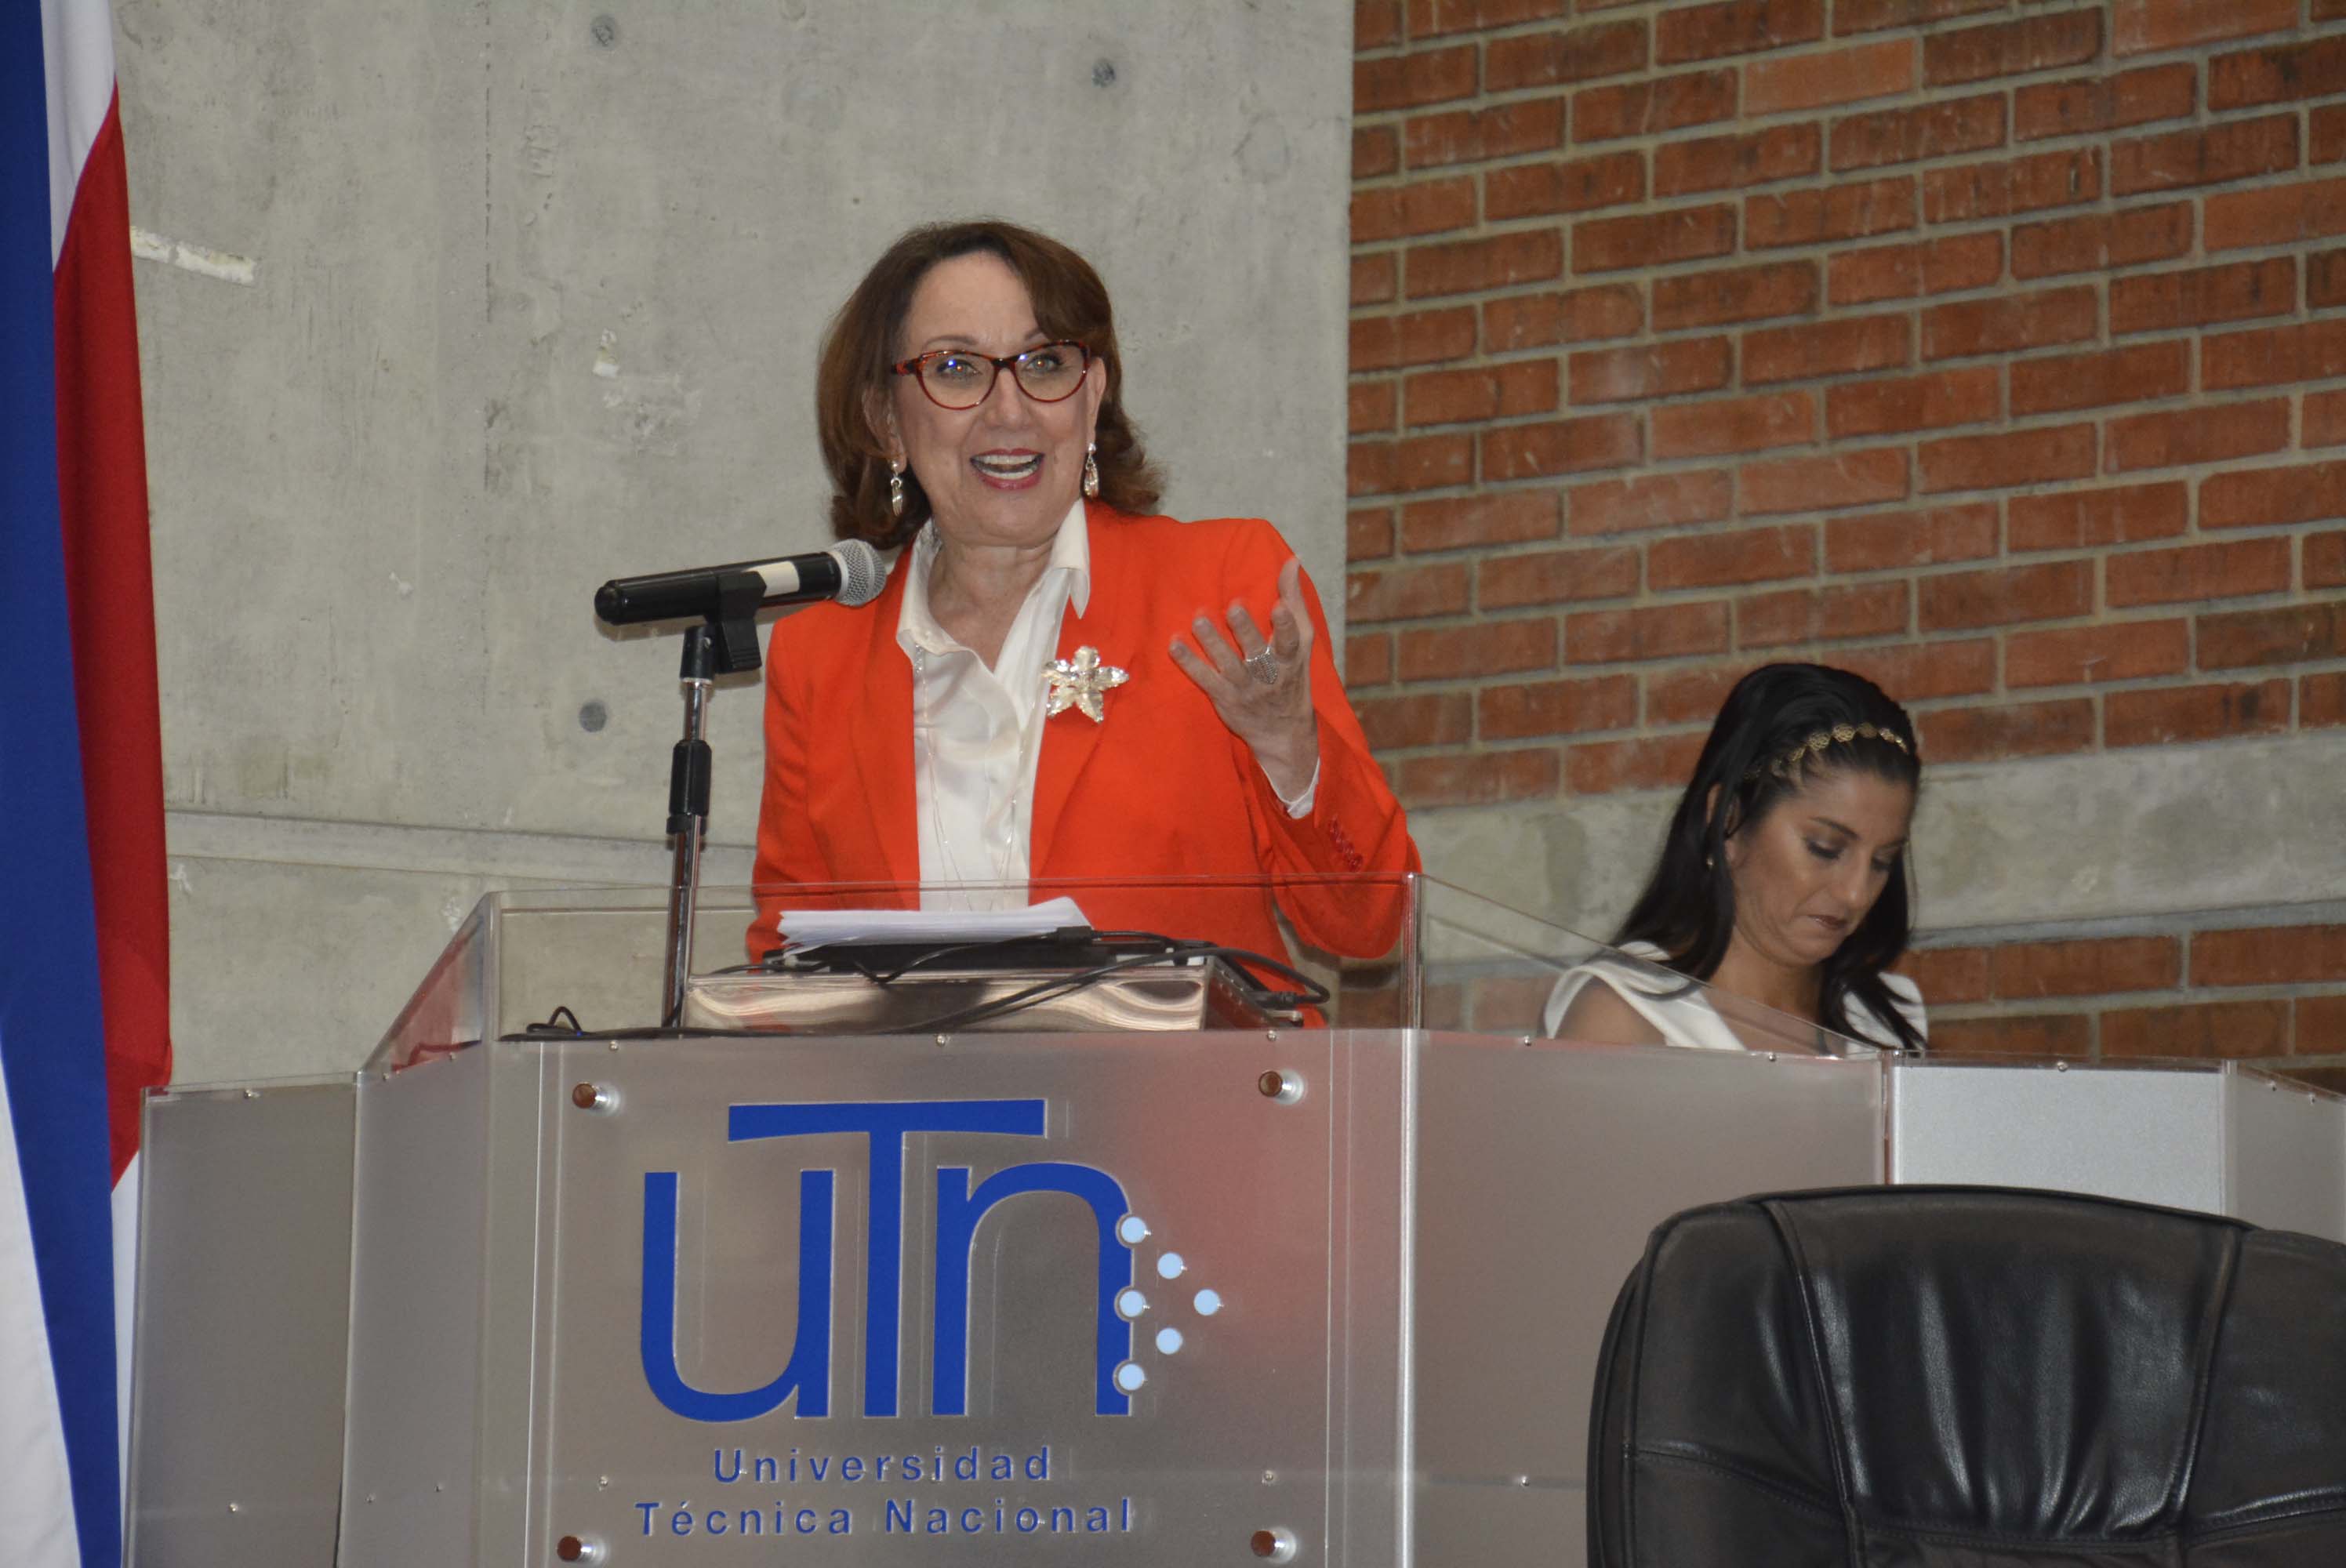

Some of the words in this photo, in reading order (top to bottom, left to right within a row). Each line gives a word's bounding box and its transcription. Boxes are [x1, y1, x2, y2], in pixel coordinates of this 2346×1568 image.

[714, 1446, 1050, 1483] Universidad
[636, 1502, 851, 1536] Técnica
[886, 1499, 1130, 1534] Nacional
